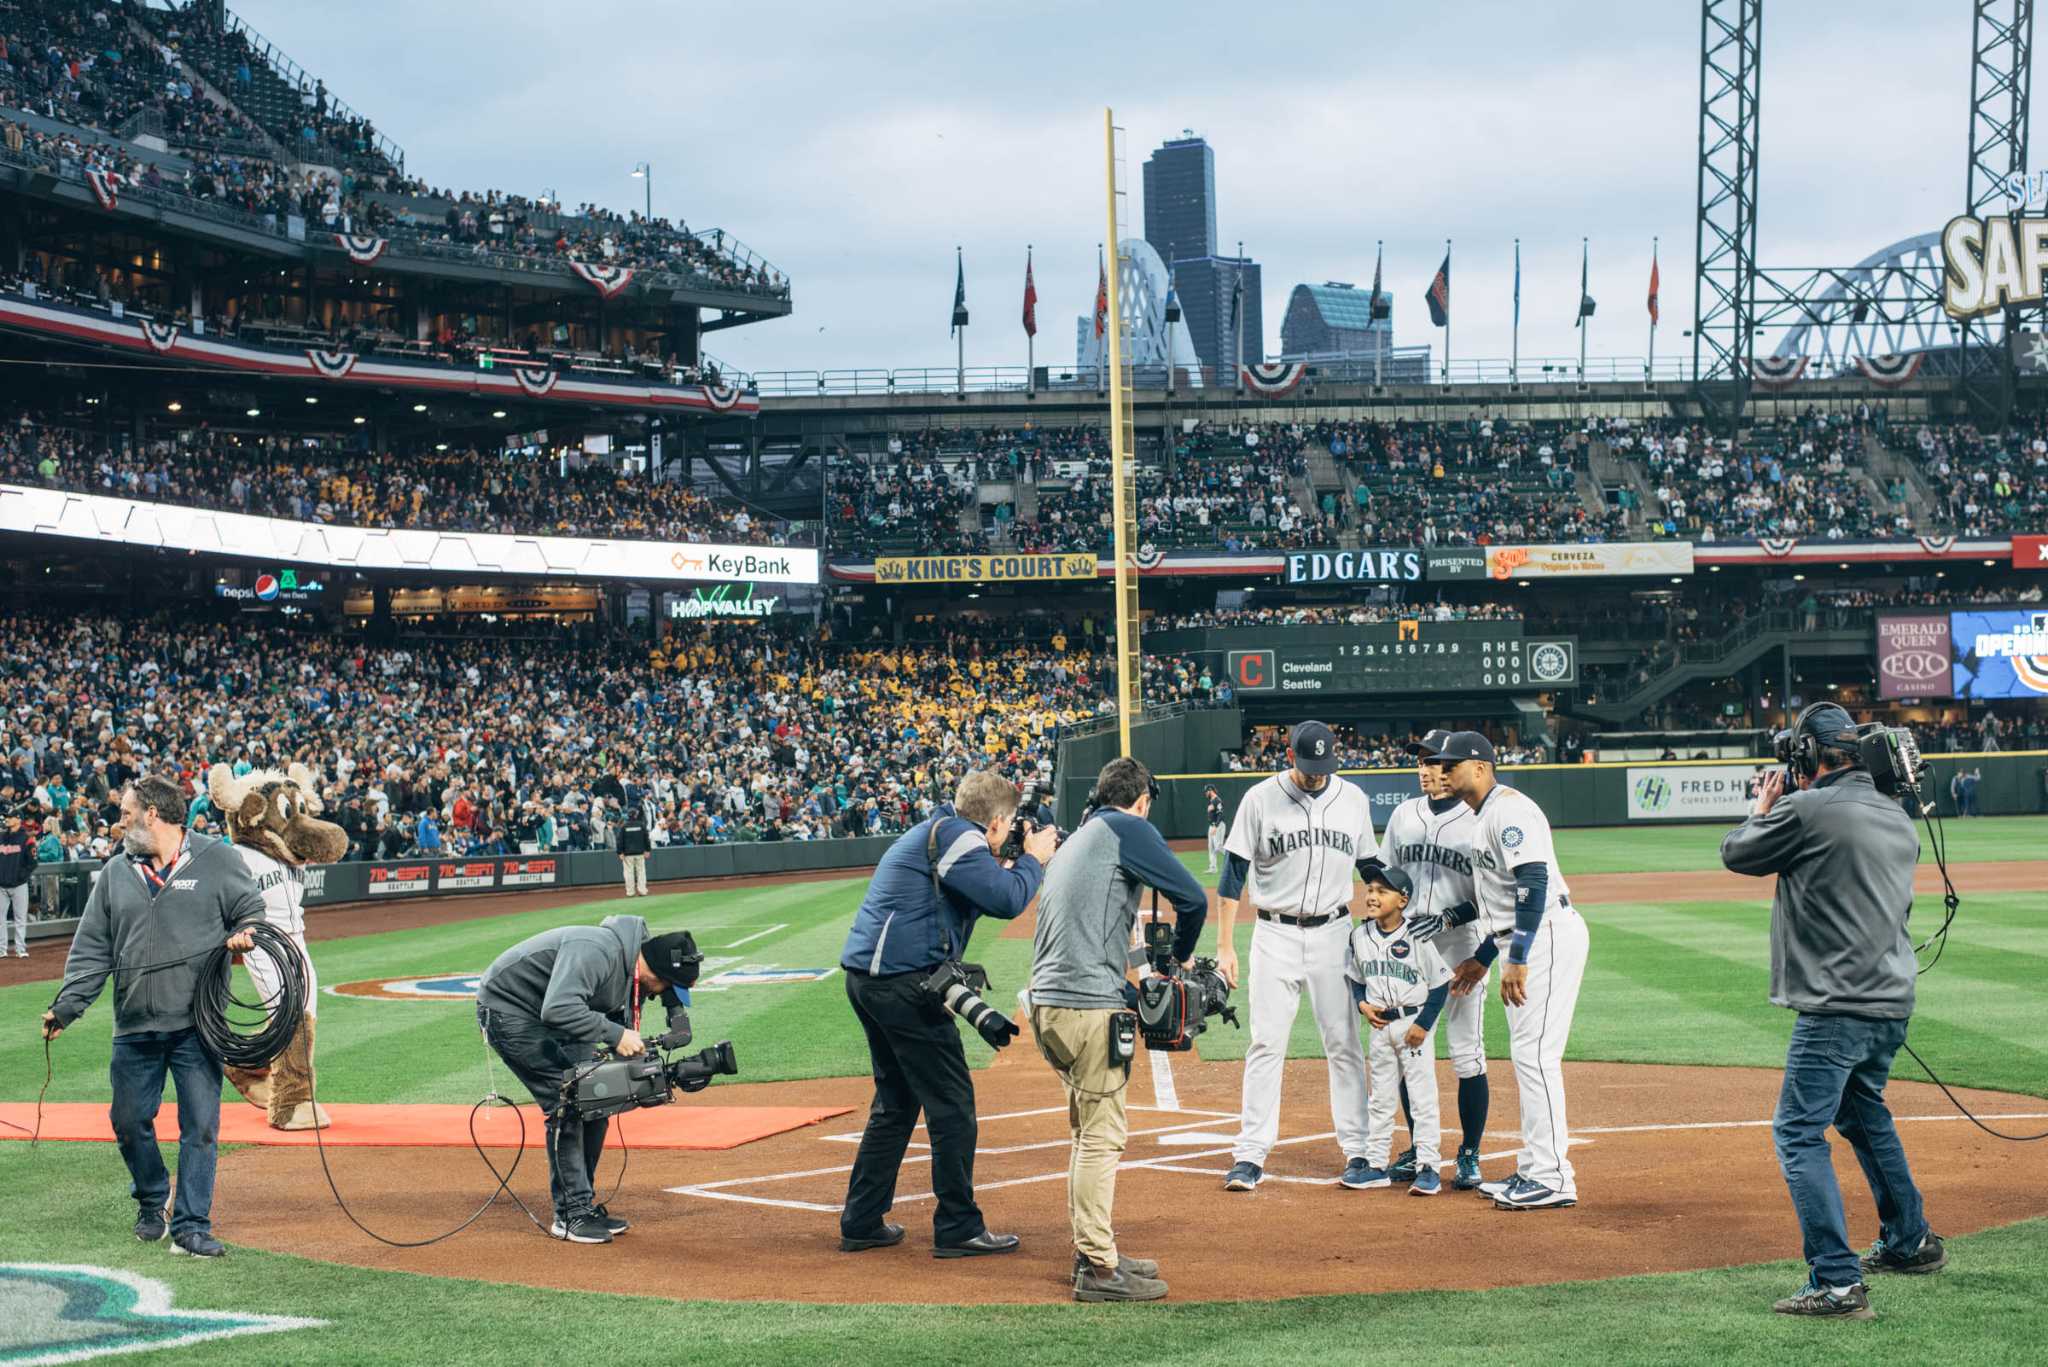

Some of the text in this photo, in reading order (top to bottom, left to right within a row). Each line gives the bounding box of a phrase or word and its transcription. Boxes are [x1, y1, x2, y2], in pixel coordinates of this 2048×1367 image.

[1429, 557, 1485, 568] PRESENTED
[1551, 551, 1596, 562] CERVEZA
[708, 553, 791, 577] KeyBank
[906, 556, 1067, 581] KING'S COURT
[1288, 551, 1421, 583] EDGAR'S
[1449, 565, 1462, 574] BY
[1880, 623, 1948, 636] EMERALD
[1339, 641, 1519, 655] 1 2 3 4 5 6 7 8 9 R H E
[1890, 635, 1937, 649] QUEEN
[1282, 662, 1333, 673] Cleveland
[1282, 679, 1322, 690] Seattle
[1896, 683, 1935, 692] CASINO
[1680, 780, 1725, 793] FRED
[1713, 796, 1739, 804] START
[1267, 827, 1355, 858] MARINERS
[369, 865, 430, 881] 710 ESPN
[438, 863, 495, 877] 710 ESPN
[503, 859, 556, 874] 710 ESPN
